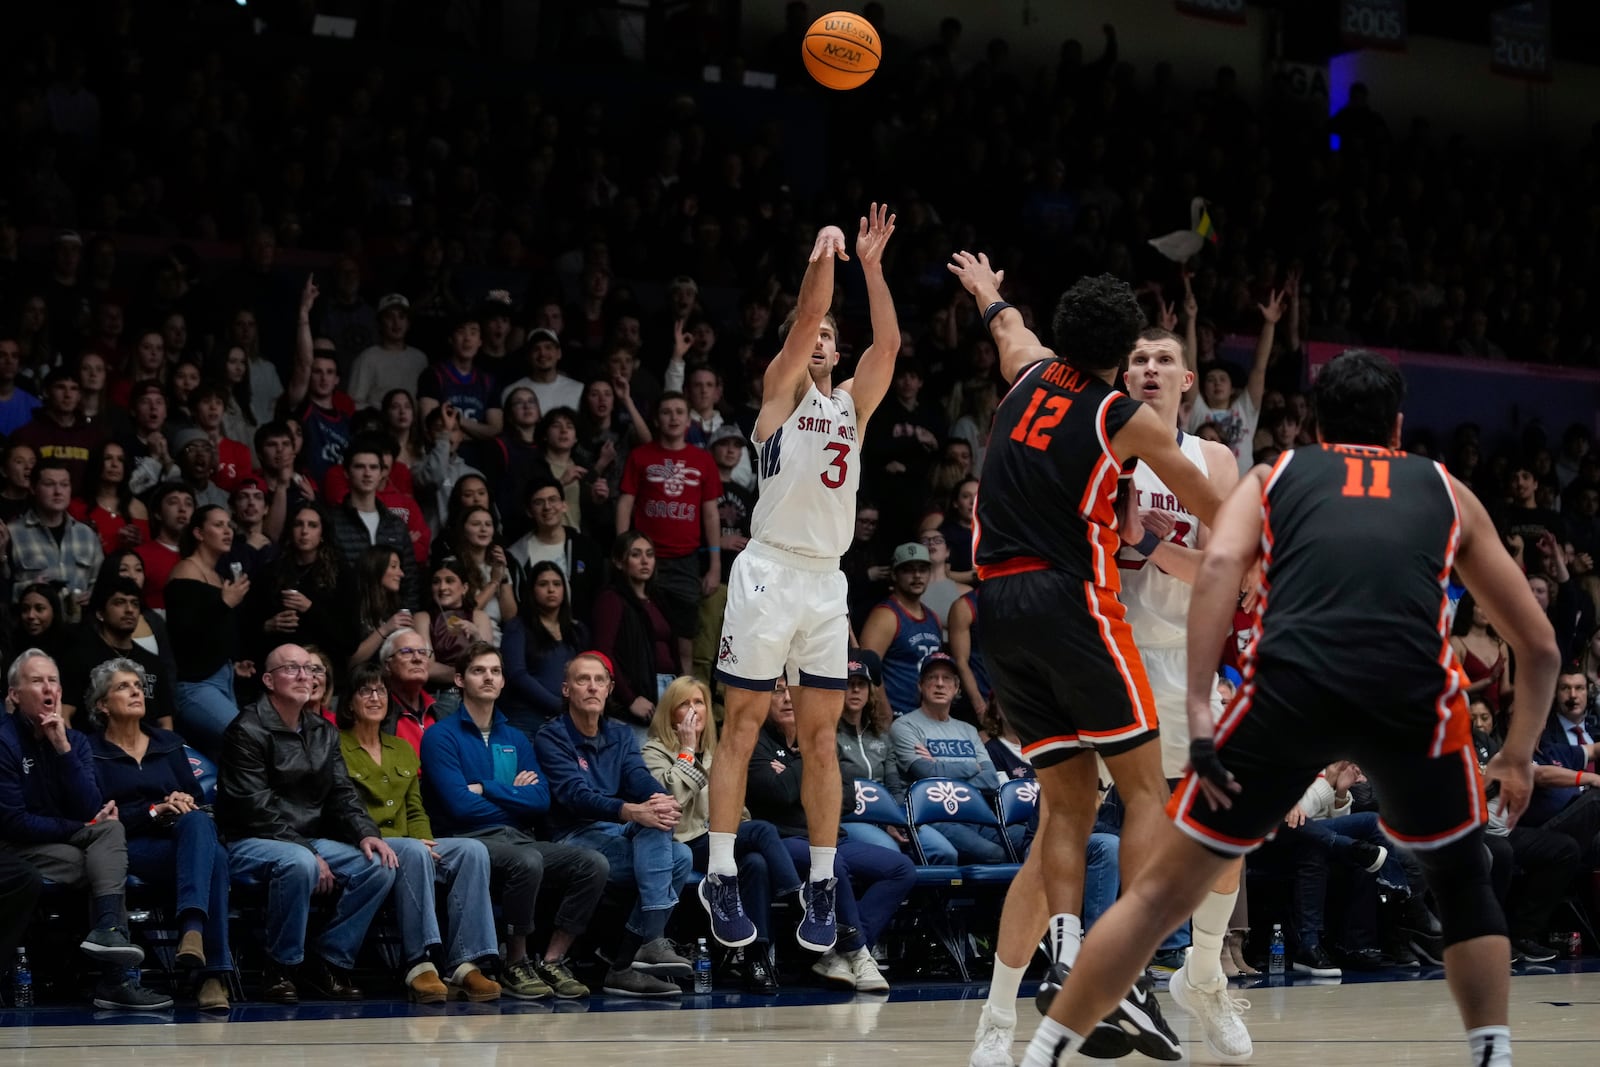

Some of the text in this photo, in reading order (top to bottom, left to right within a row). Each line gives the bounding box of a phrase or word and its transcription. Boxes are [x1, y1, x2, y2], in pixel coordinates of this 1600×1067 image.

[1344, 4, 1400, 39] 2005
[824, 42, 863, 63] NCAA
[1492, 36, 1545, 72] 2004
[1041, 361, 1092, 393] RATAJ
[797, 416, 832, 434] SAINT
[1010, 387, 1073, 452] 12
[820, 441, 851, 489] 3
[1341, 457, 1391, 498] 11
[644, 499, 697, 523] GAELS
[1151, 492, 1192, 515] MAR
[928, 740, 975, 755] GAELS
